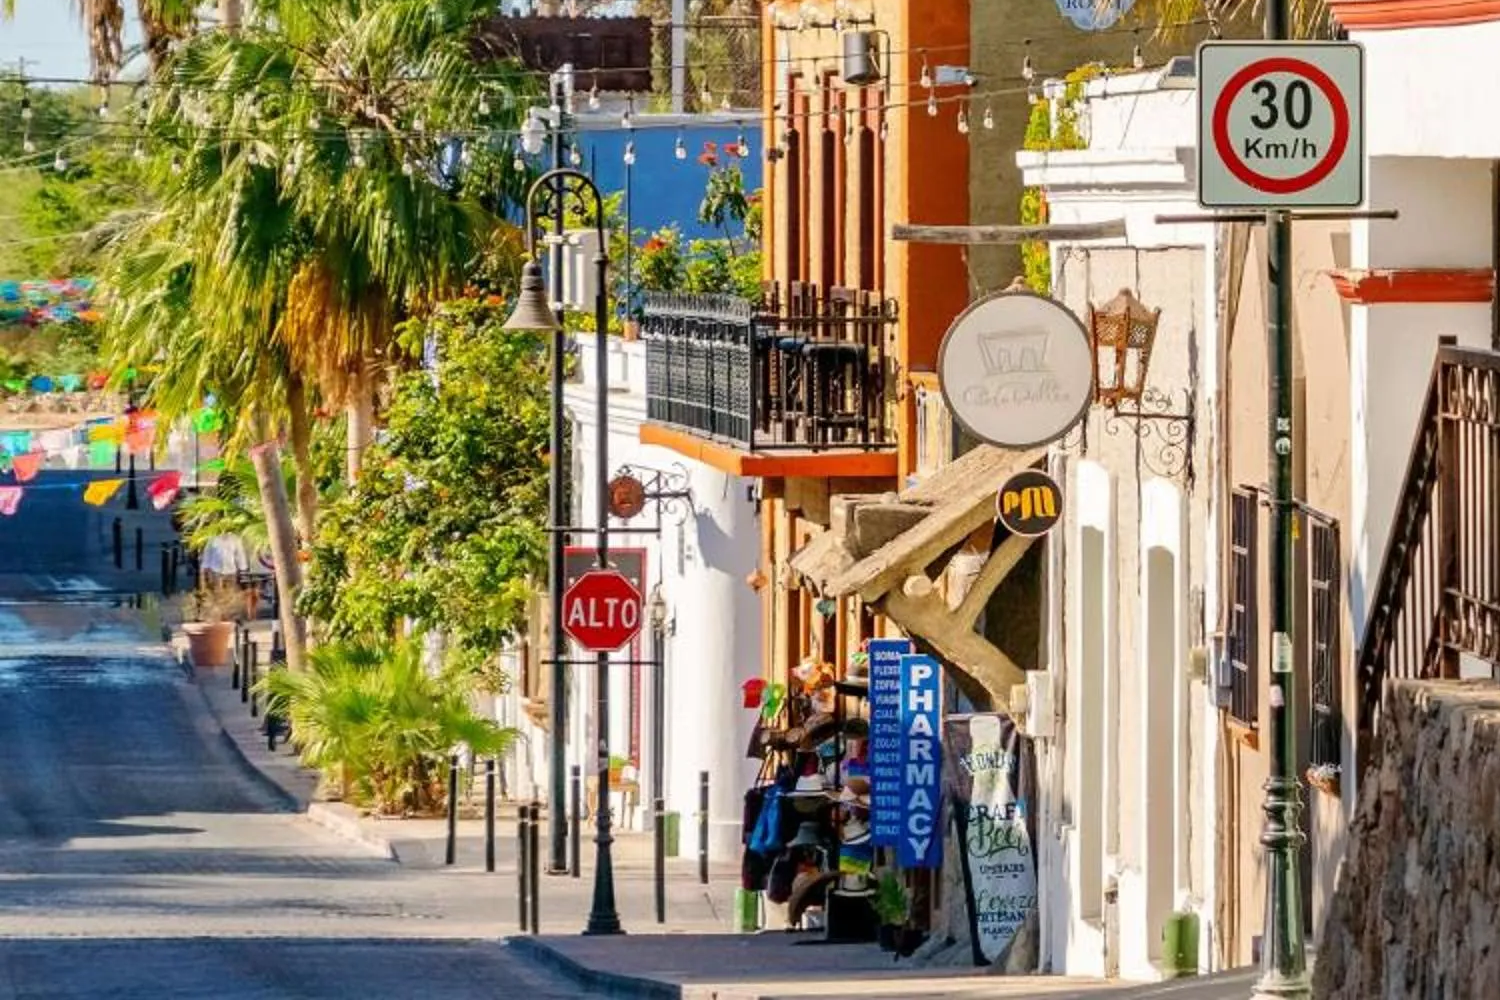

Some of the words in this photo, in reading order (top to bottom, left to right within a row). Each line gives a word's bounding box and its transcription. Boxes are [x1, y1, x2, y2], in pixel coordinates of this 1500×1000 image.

[1251, 79, 1312, 130] 30
[1244, 137, 1317, 159] Km/h
[568, 597, 638, 629] ALTO
[907, 664, 935, 860] PHARMACY
